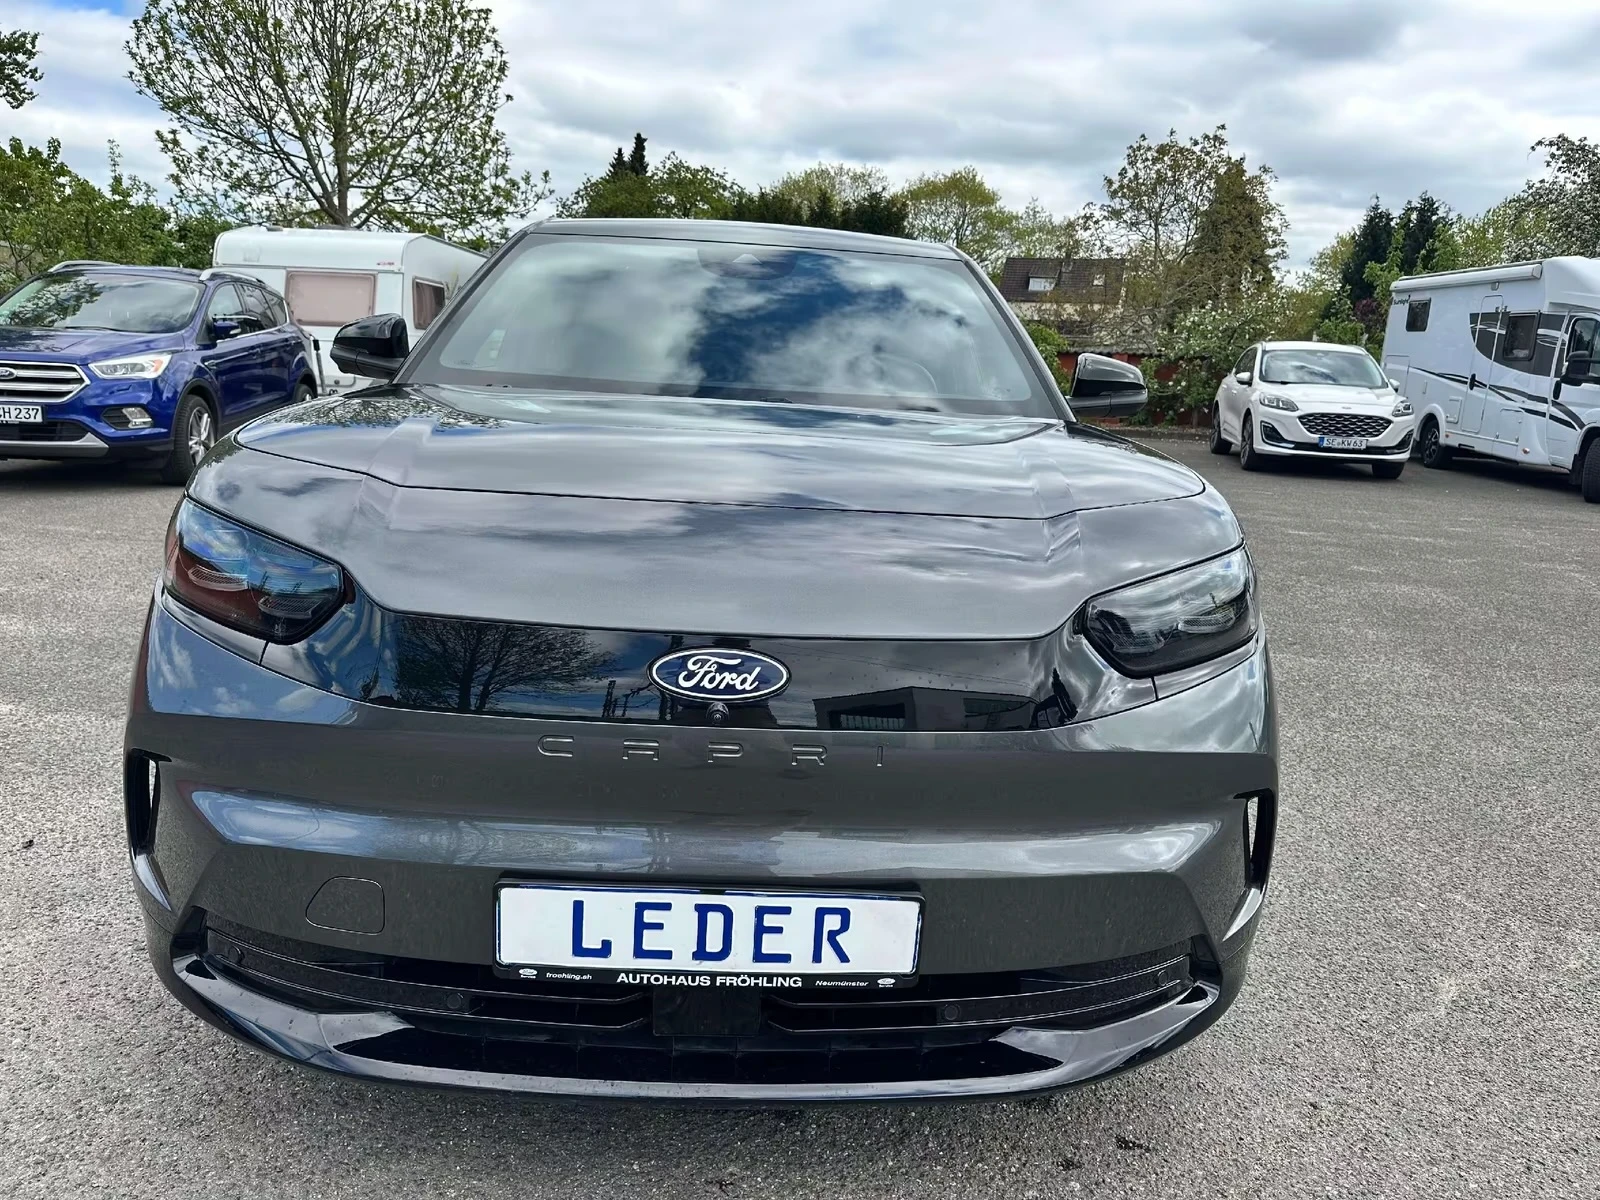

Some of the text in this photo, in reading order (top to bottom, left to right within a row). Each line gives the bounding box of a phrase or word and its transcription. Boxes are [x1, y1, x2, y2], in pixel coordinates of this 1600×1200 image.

[0, 406, 40, 420] H 237
[1326, 438, 1336, 446] SE
[678, 655, 761, 691] Ford
[537, 734, 884, 768] CAPRI
[571, 899, 851, 964] LEDER
[616, 972, 802, 988] AUTOHAUS FRÖHLING
